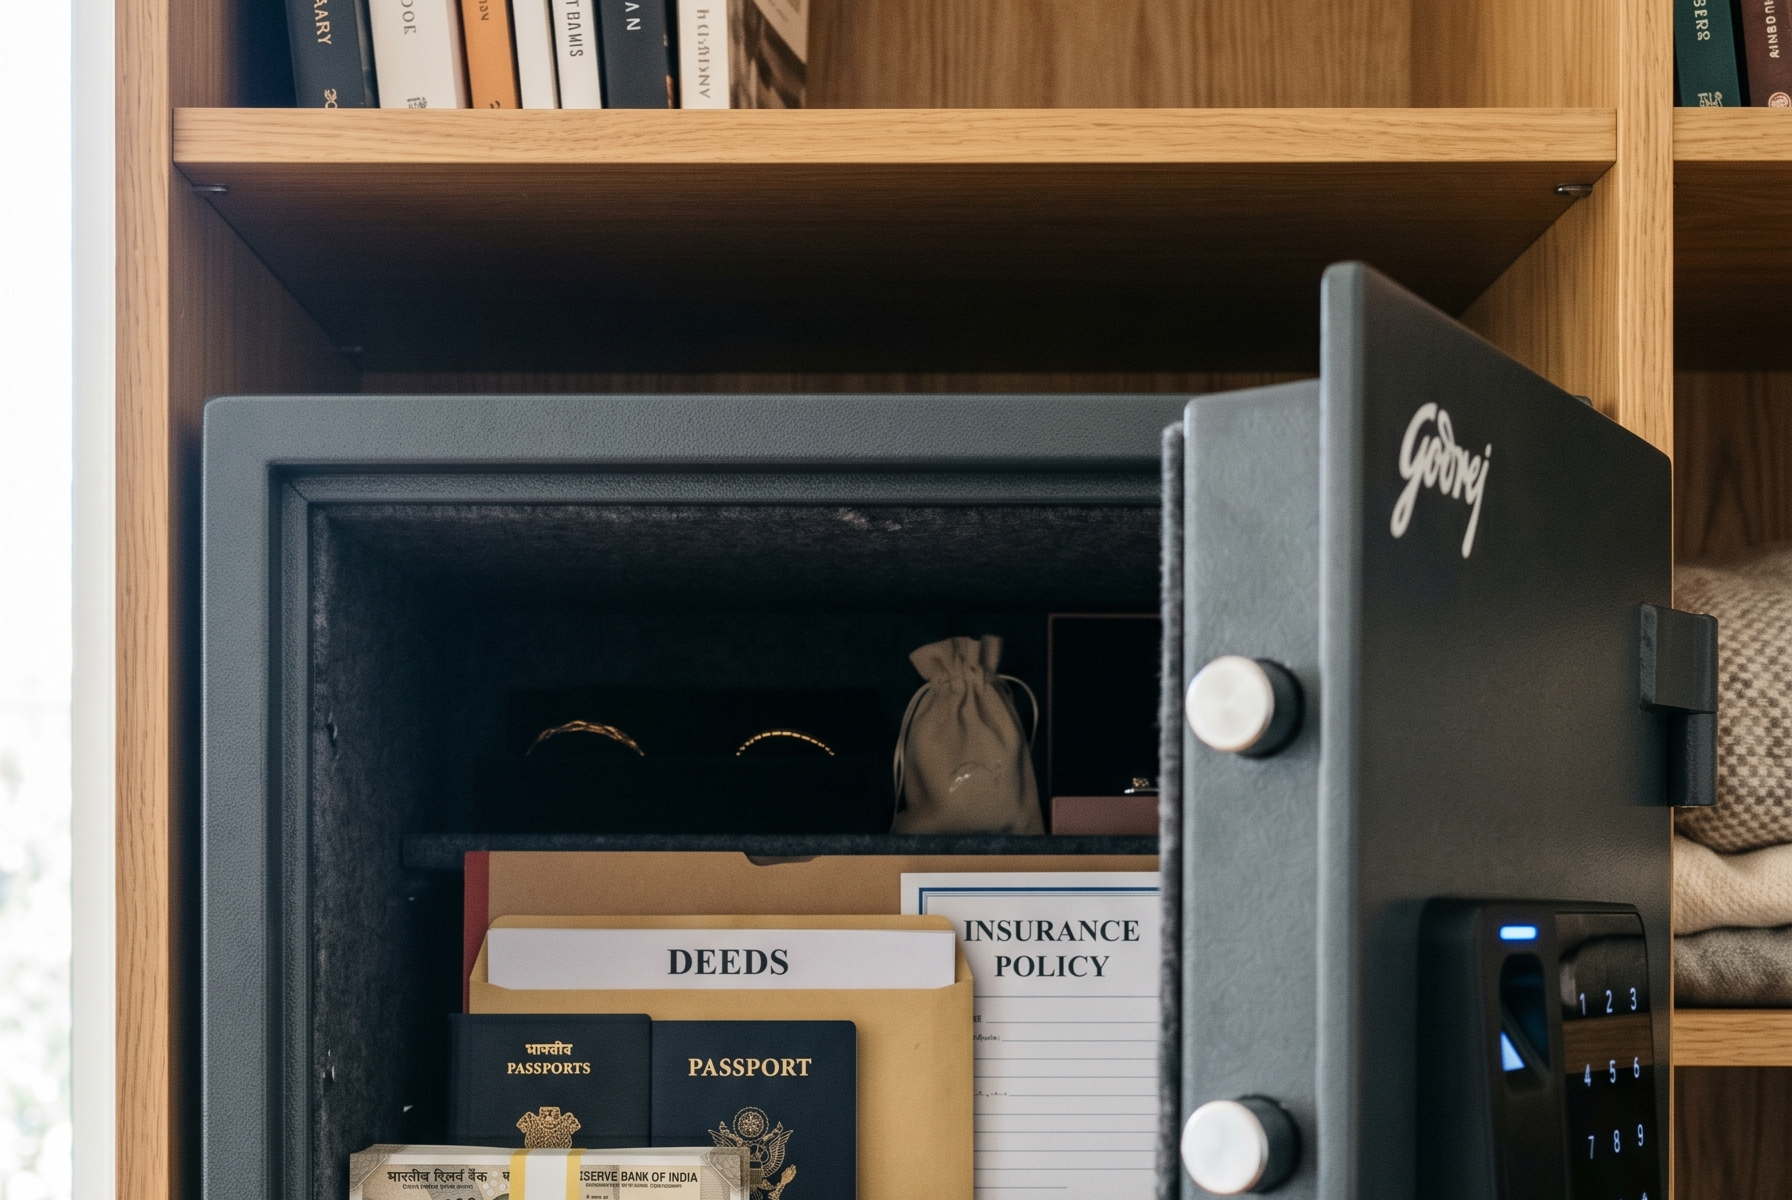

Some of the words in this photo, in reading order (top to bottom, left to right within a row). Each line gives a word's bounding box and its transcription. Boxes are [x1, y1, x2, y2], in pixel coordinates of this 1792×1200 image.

[1390, 402, 1492, 559] Godrej
[963, 919, 1140, 942] INSURANCE
[667, 948, 789, 976] DEEDS
[995, 955, 1110, 978] POLICY
[1579, 992, 1586, 1016] 1
[1605, 989, 1613, 1014] 2
[1629, 987, 1637, 1011] 3
[507, 1062, 591, 1075] PASSPORTS
[688, 1057, 812, 1077] PASSPORT
[1584, 1063, 1592, 1086] 4
[1609, 1059, 1616, 1083] 5
[1633, 1056, 1640, 1078] 6
[1587, 1135, 1595, 1159] 7
[1613, 1129, 1621, 1153] 8
[1637, 1123, 1644, 1147] 9
[620, 1171, 649, 1182] BANK
[651, 1171, 666, 1183] OF
[668, 1172, 698, 1183] INDIA
